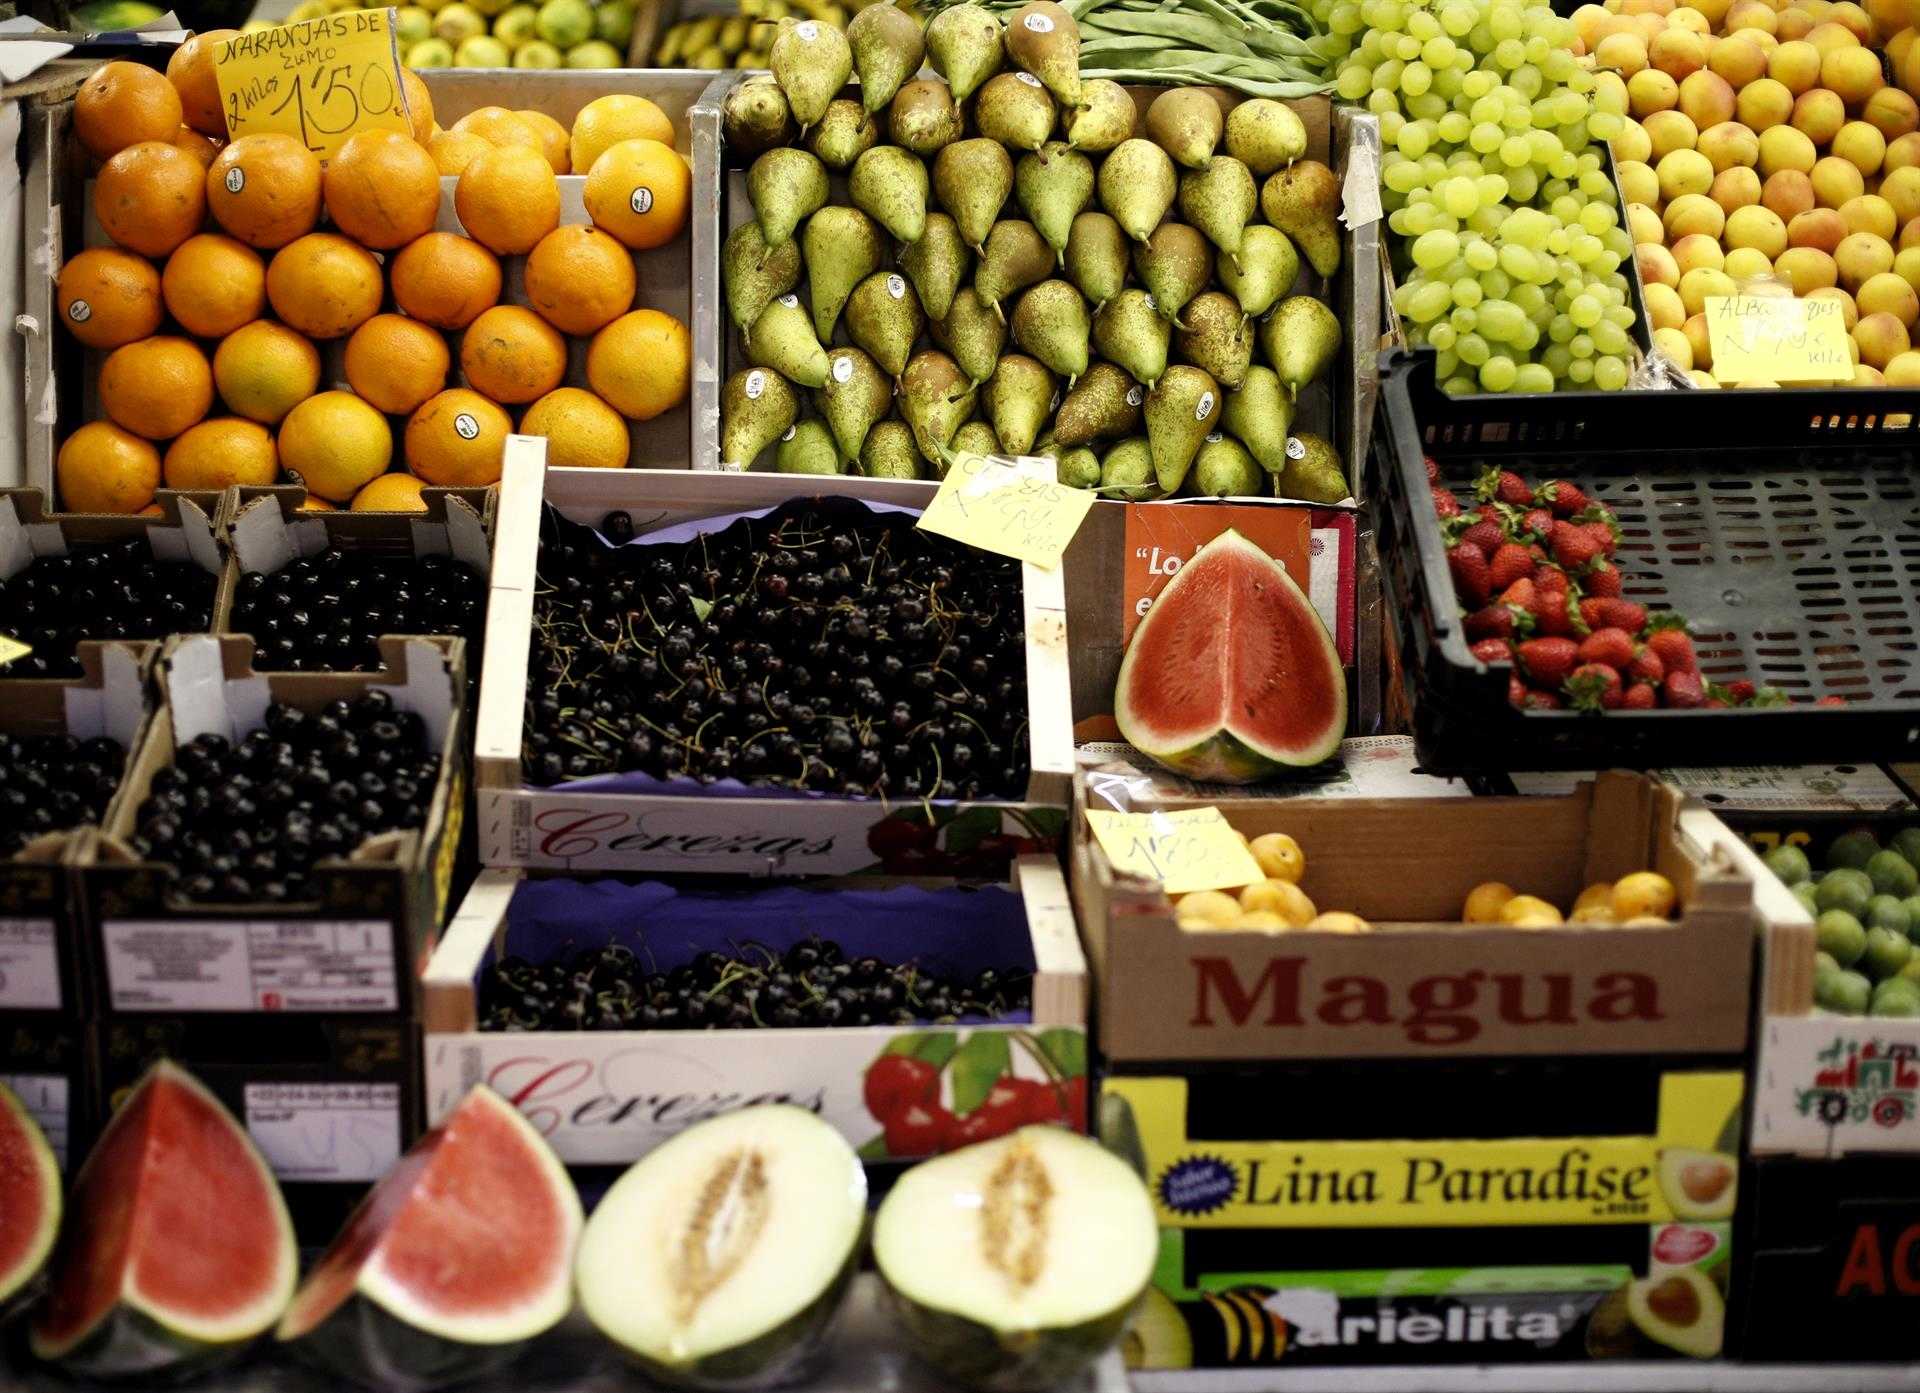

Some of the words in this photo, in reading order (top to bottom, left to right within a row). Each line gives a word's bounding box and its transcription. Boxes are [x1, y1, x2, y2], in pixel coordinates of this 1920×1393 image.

[218, 16, 348, 65] NARANJAS
[355, 13, 381, 33] DE
[228, 92, 246, 132] 2
[534, 807, 837, 858] Cerezas
[1188, 955, 1666, 1047] Magua
[1242, 1156, 1382, 1206] Lina
[1400, 1148, 1650, 1203] Paradise
